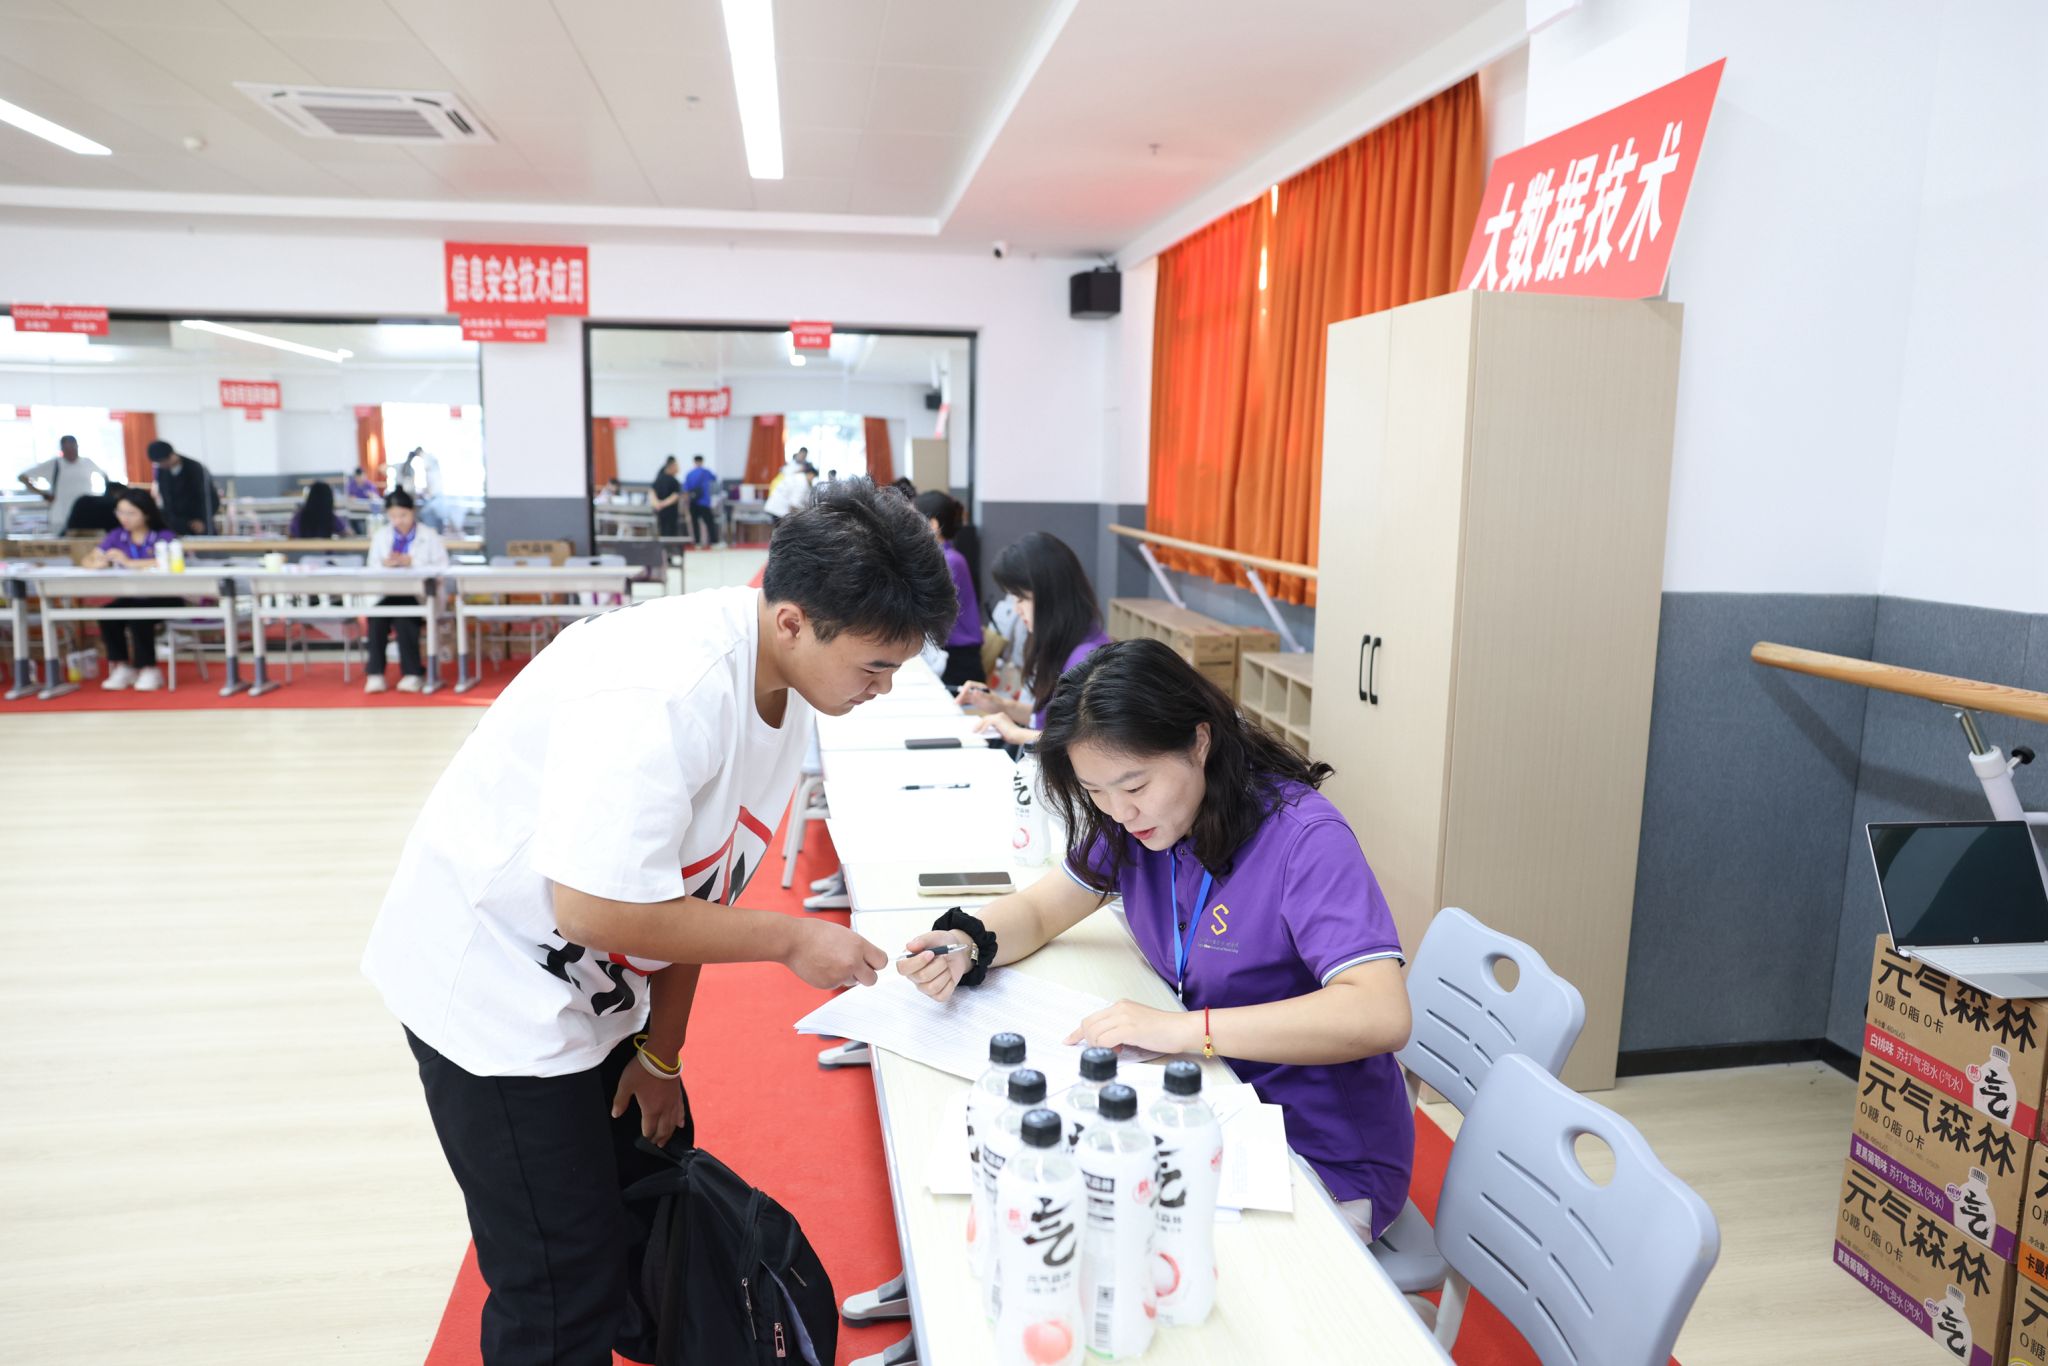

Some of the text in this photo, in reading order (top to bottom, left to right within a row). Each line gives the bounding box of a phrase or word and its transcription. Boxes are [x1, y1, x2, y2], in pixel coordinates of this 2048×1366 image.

[1468, 120, 1683, 292] 大数据技术
[452, 254, 584, 304] 信息安全技术应用
[1870, 1033, 1894, 1056] 白桃味
[1877, 947, 2037, 1053] 元气森林
[1862, 1060, 2016, 1177] 元气森林
[1844, 1169, 1991, 1296] 元气森林
